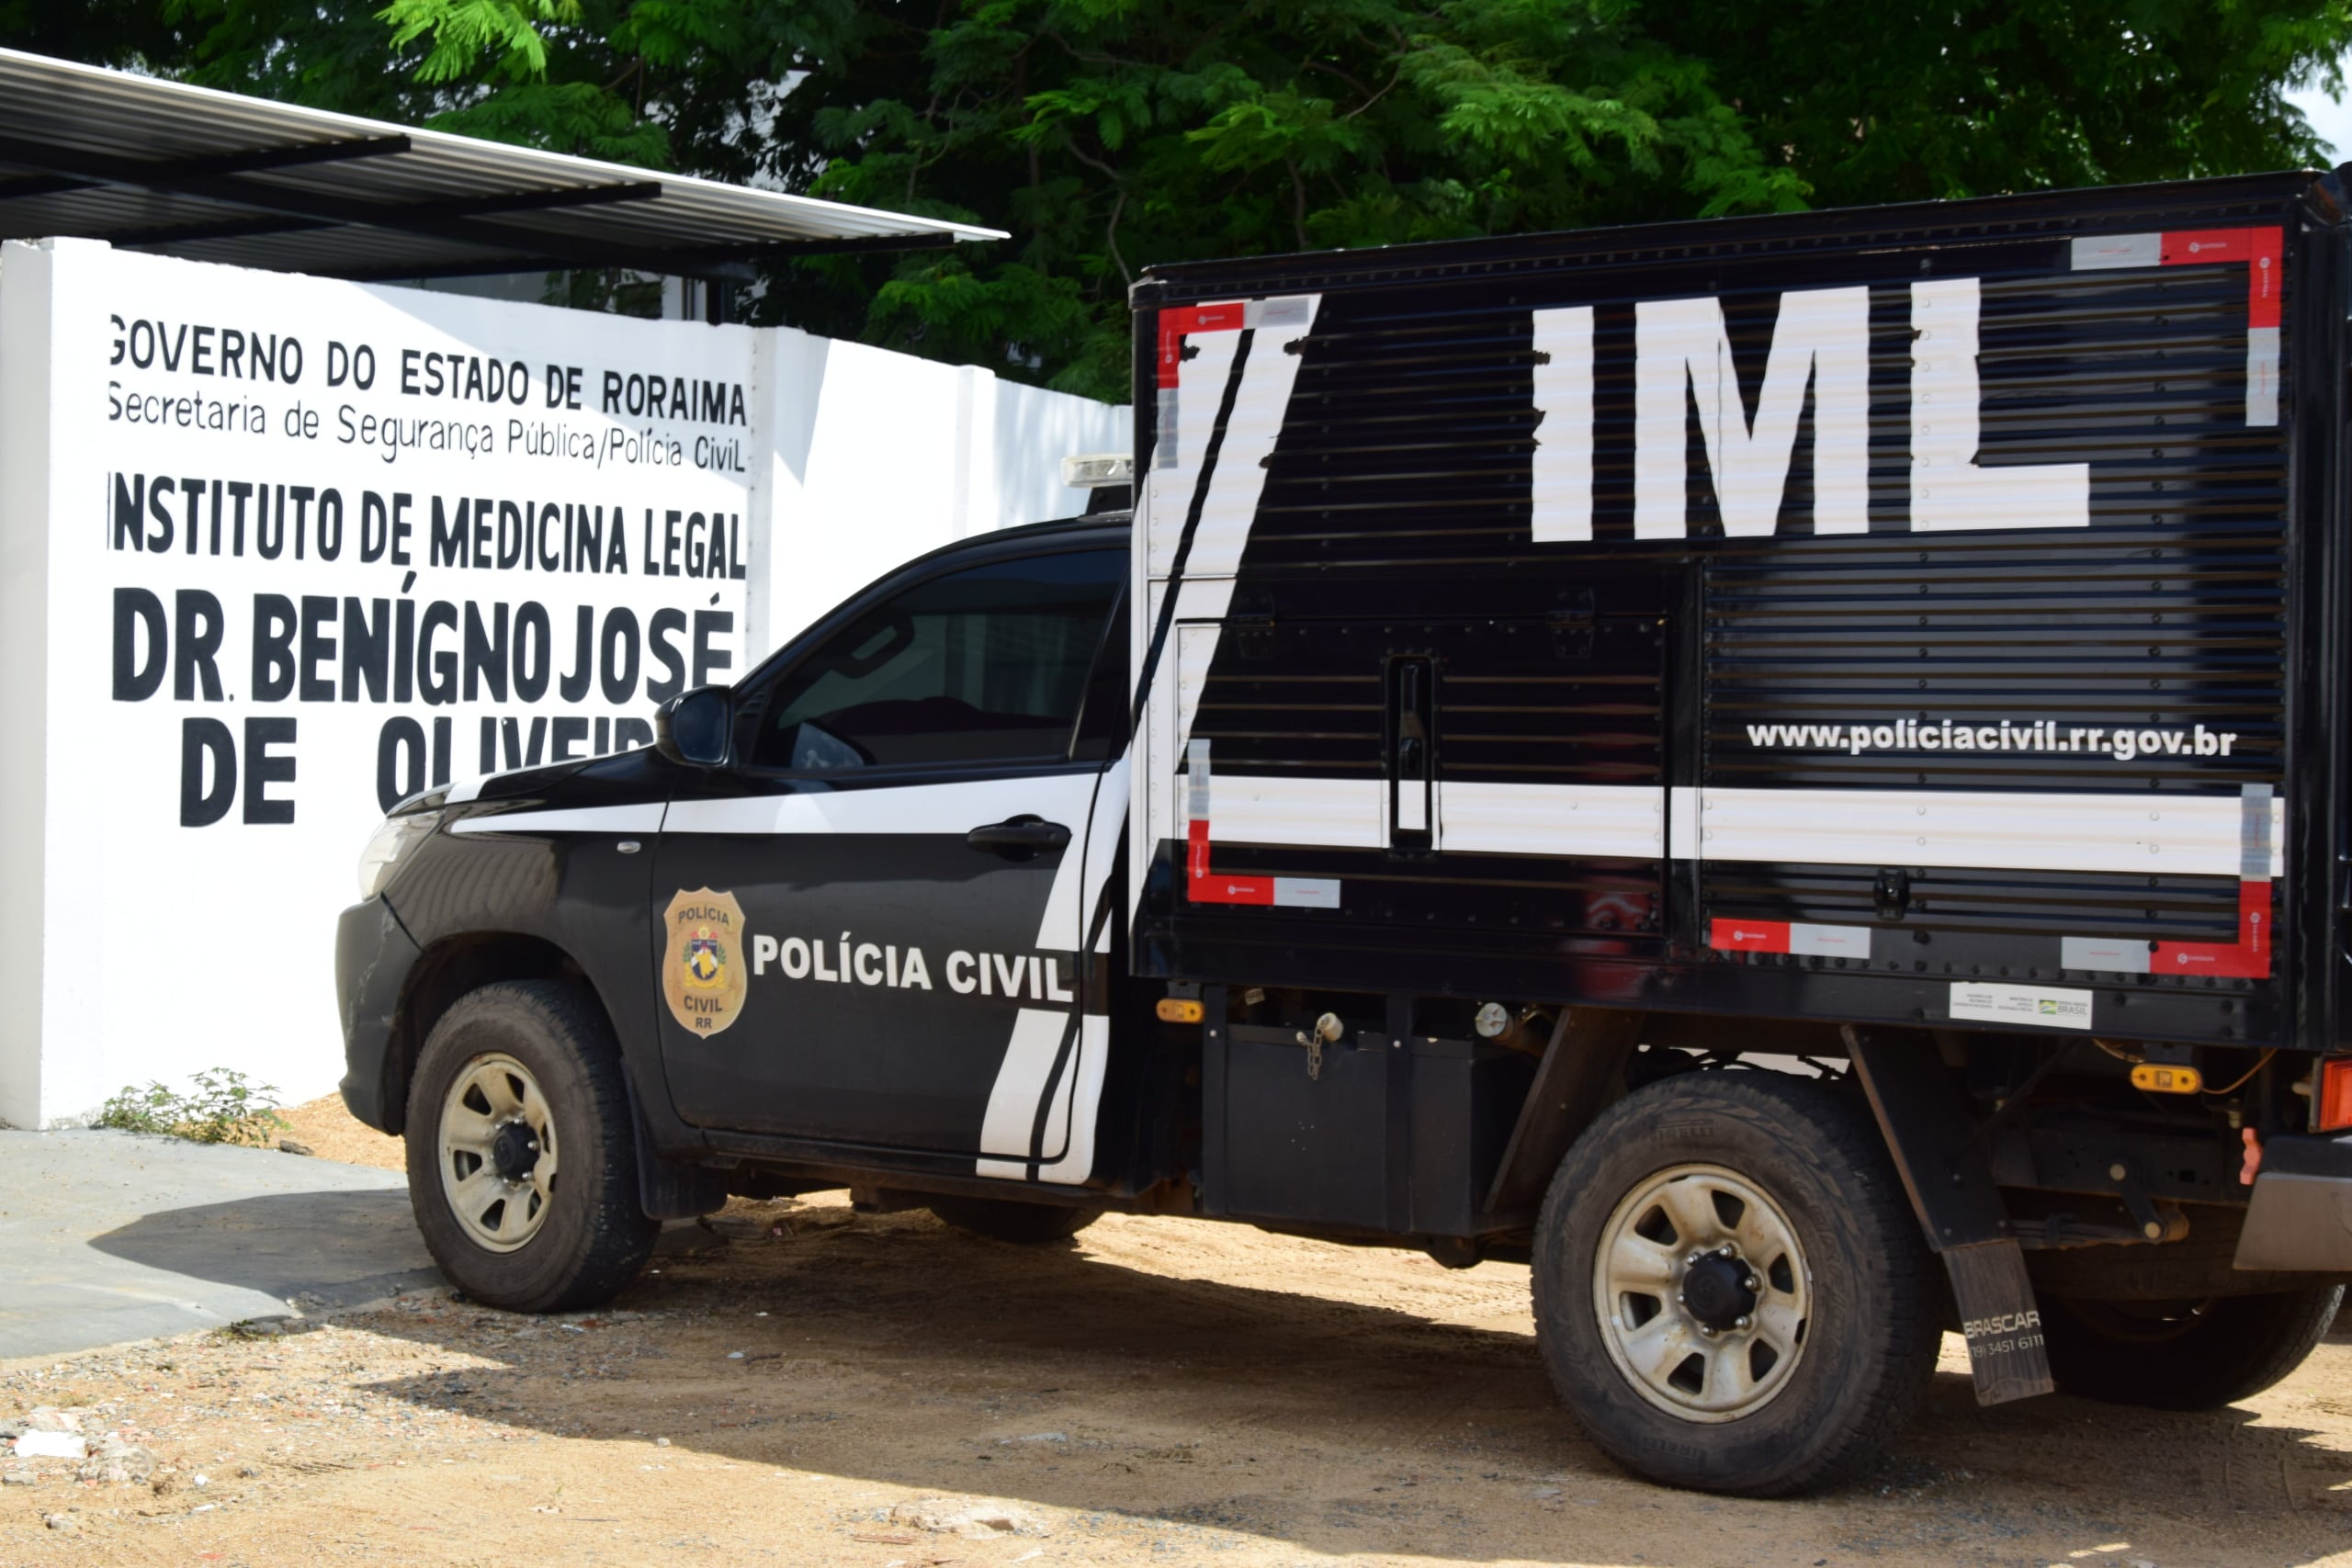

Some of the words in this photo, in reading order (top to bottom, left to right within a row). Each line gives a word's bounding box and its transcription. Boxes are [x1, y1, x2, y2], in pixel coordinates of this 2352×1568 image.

[110, 313, 303, 385] GOVERNO
[327, 341, 377, 390] DO
[401, 349, 529, 406] ESTADO
[546, 364, 583, 412] DE
[603, 369, 747, 427] RORAIMA
[109, 380, 266, 434] Secretaria
[285, 400, 319, 439] de
[337, 404, 493, 464] Segurança
[1532, 278, 2090, 543] IML
[107, 471, 344, 562] NSTITUTO
[360, 490, 413, 566] DE
[430, 495, 628, 574] MEDICINA
[643, 508, 746, 581] LEGAL
[112, 587, 234, 703] DR.
[251, 570, 551, 706] BENÍGNO
[560, 592, 734, 705] JOSÉ
[1747, 718, 2237, 761] www.policiacivil.rr.gov.br
[180, 716, 298, 828] DE
[678, 904, 729, 927] POLÍCIA
[753, 931, 933, 990] POLÍCIA
[945, 950, 1073, 1003] CIVIL
[684, 995, 723, 1013] CIVIL
[695, 1017, 712, 1029] RR
[2057, 1004, 2087, 1016] BRASIL
[1962, 1310, 2041, 1340] BRASCAR
[2018, 1333, 2045, 1350] 6111
